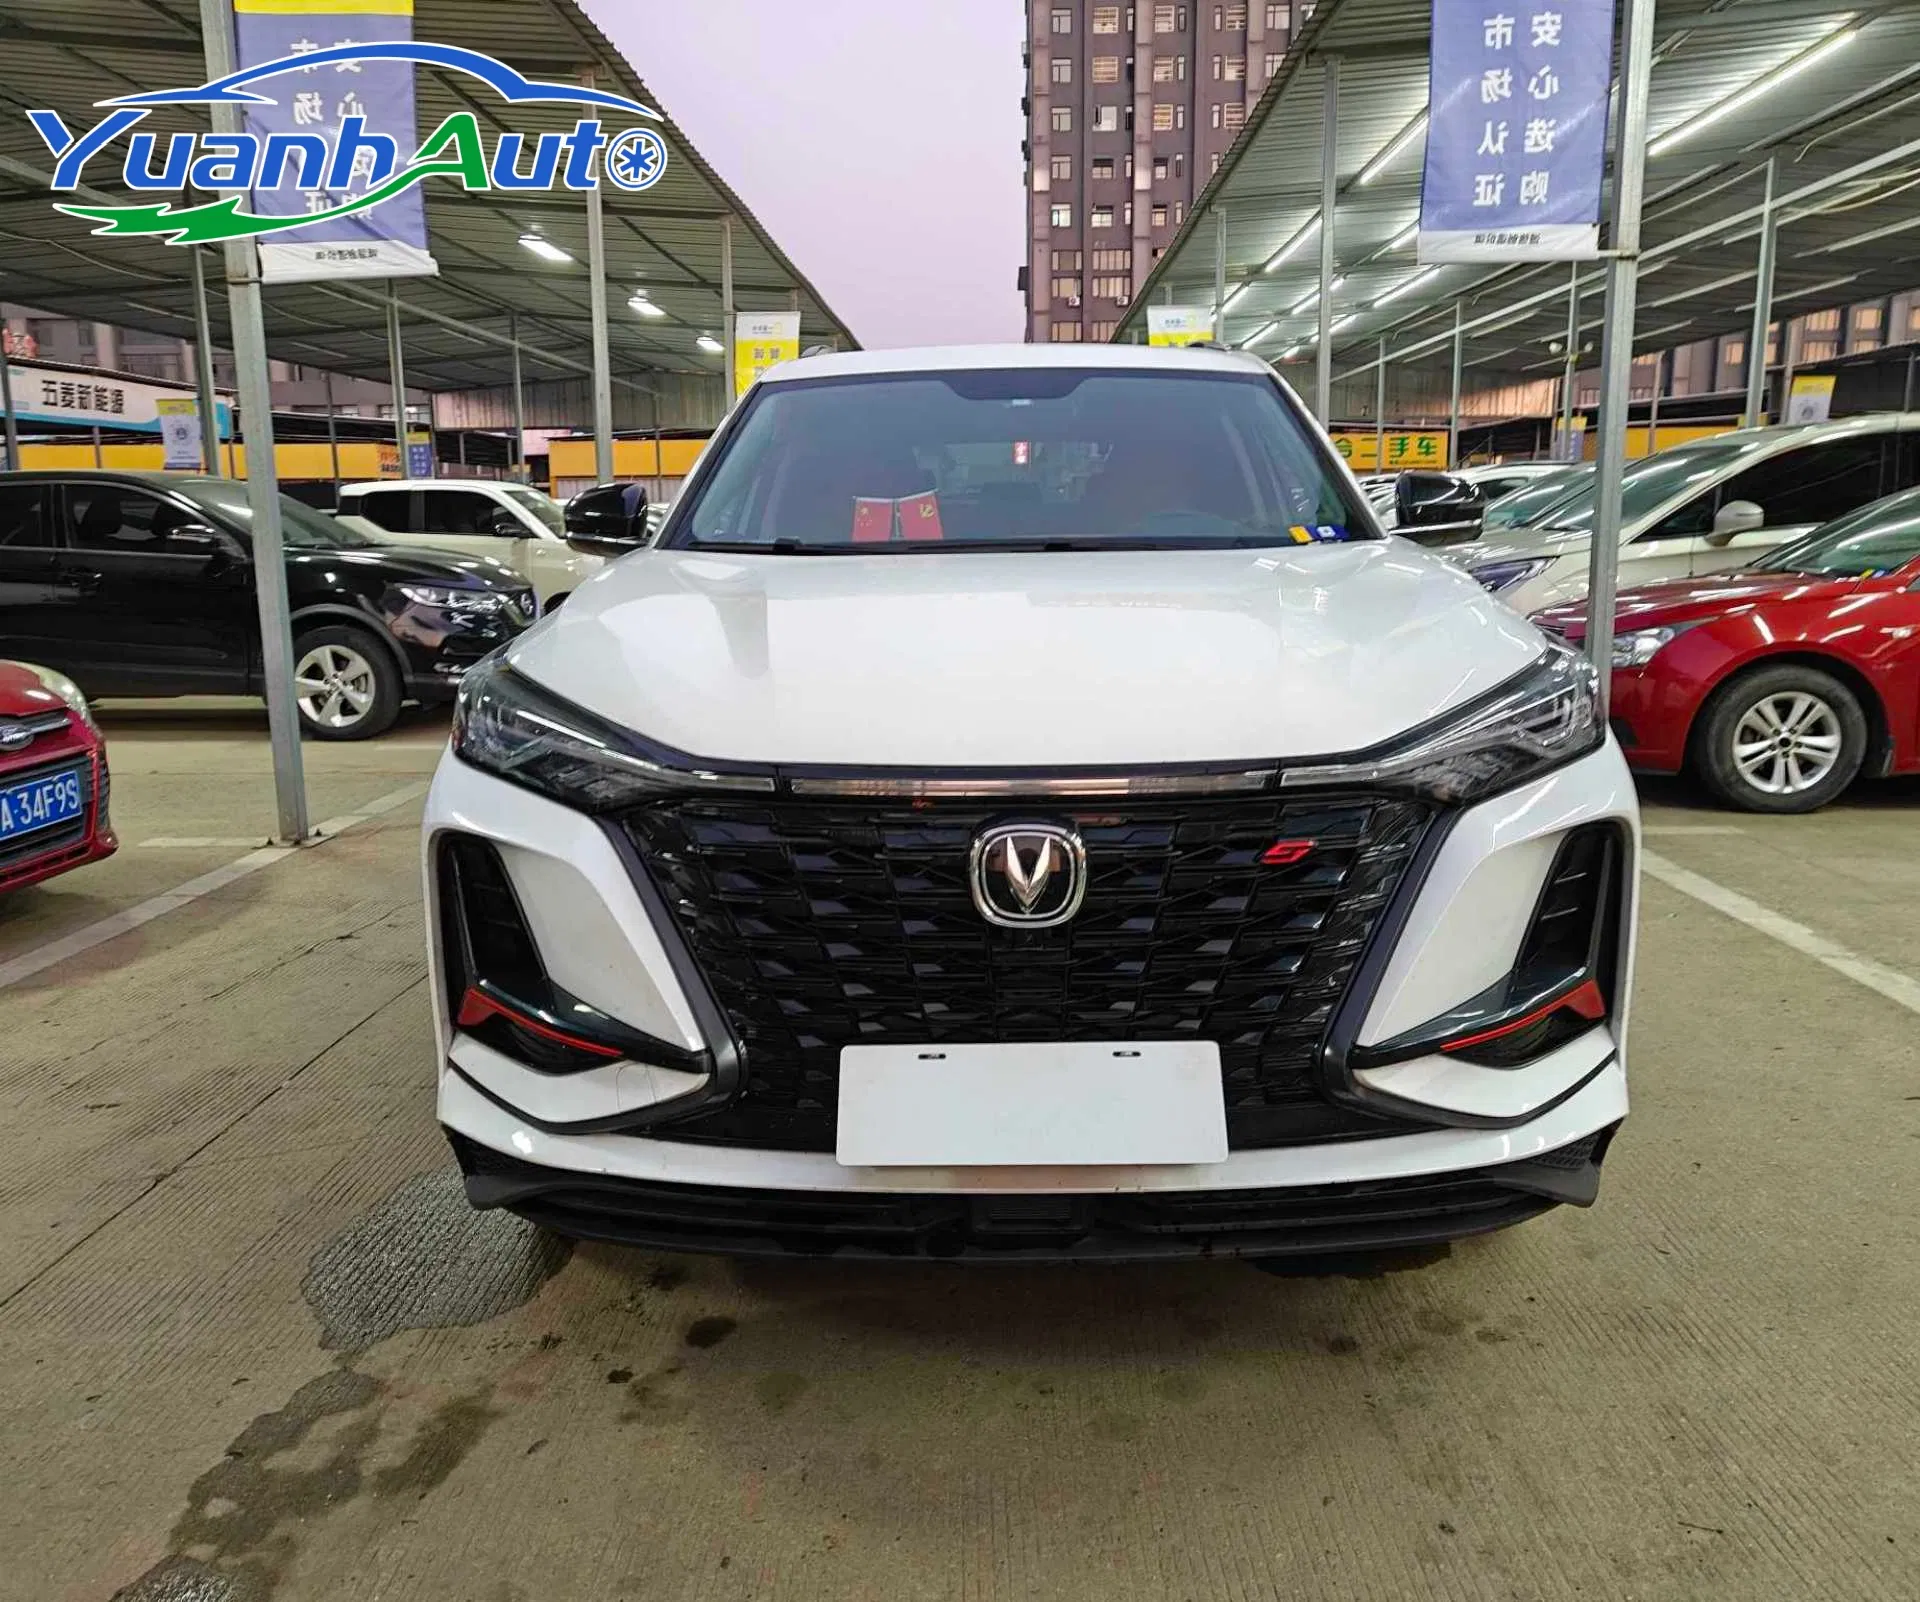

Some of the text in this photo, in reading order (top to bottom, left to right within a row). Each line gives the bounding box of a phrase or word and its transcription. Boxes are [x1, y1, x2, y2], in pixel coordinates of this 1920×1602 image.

[41, 379, 125, 414] 五菱新能源
